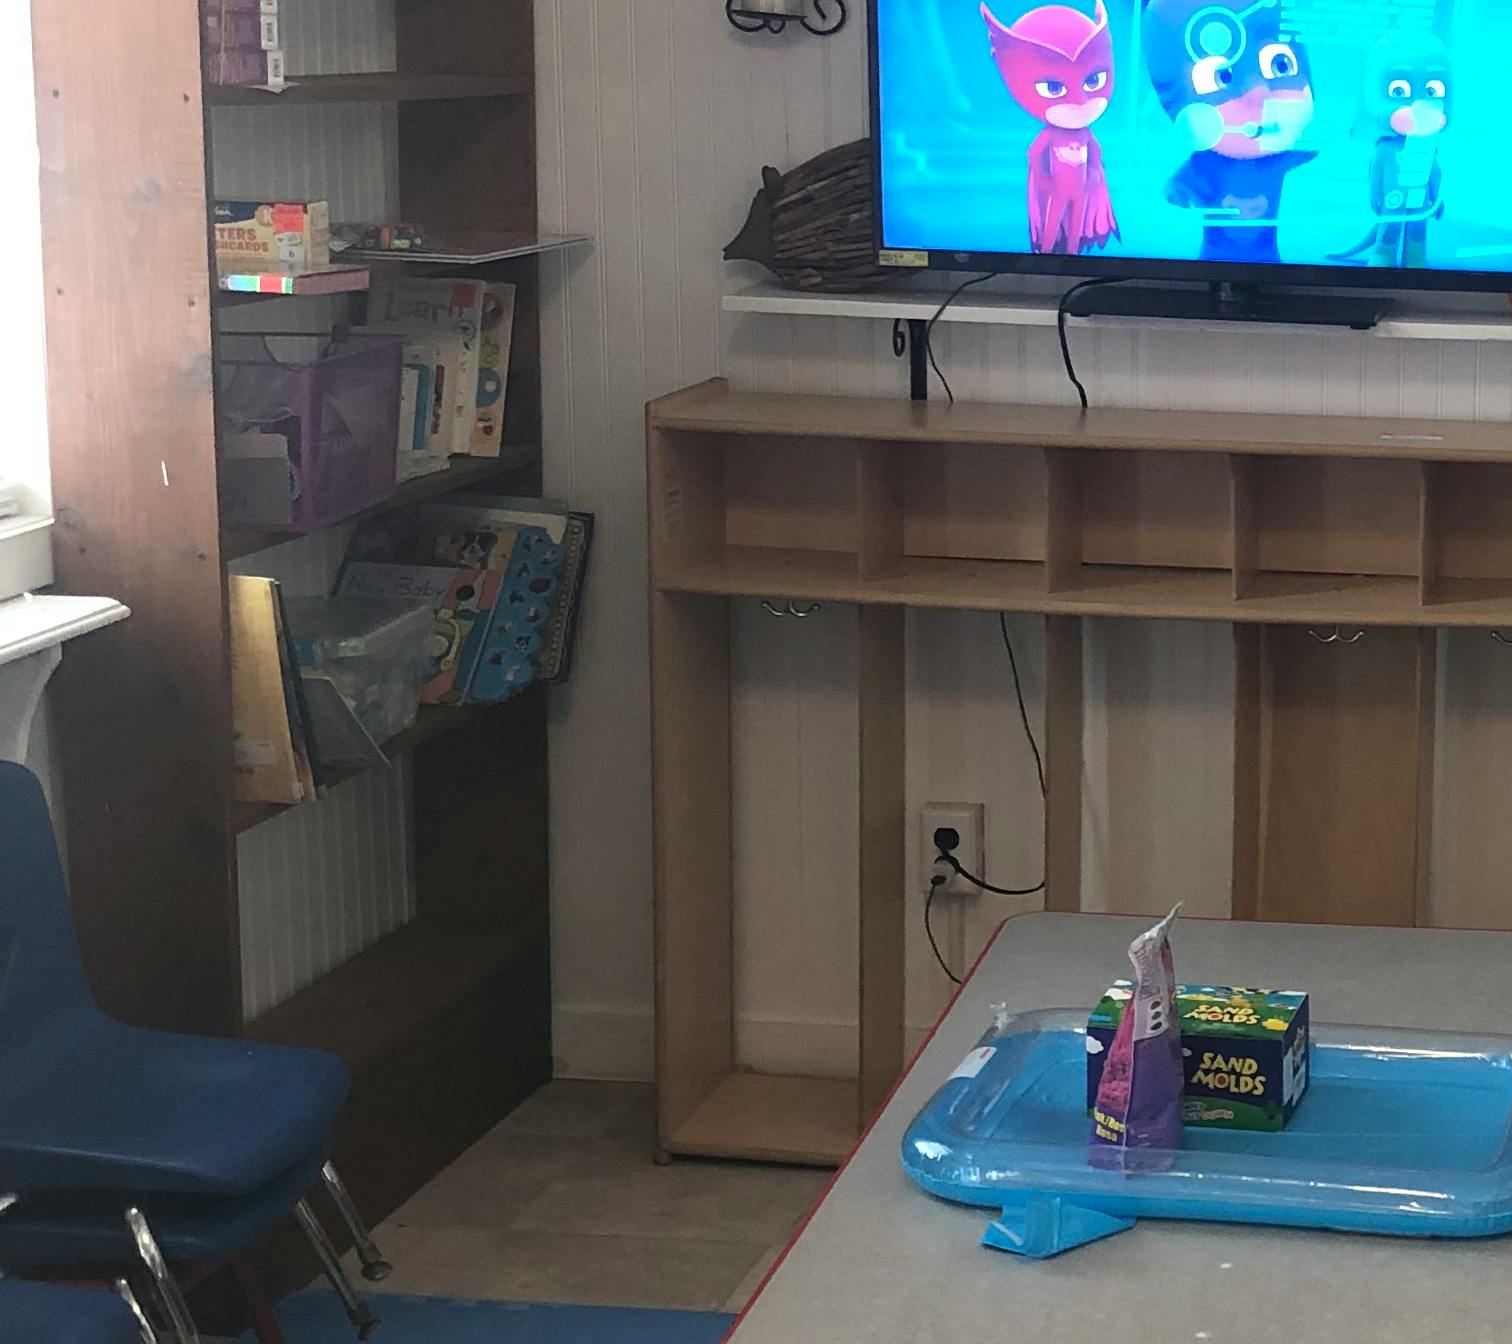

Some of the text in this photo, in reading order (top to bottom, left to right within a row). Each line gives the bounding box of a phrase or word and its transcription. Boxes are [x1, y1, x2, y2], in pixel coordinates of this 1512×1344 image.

[1183, 1011, 1261, 1025] MOLDS
[1194, 1004, 1254, 1015] SAND
[1200, 1052, 1258, 1076] SAND
[1191, 1069, 1267, 1096] MOLDS
